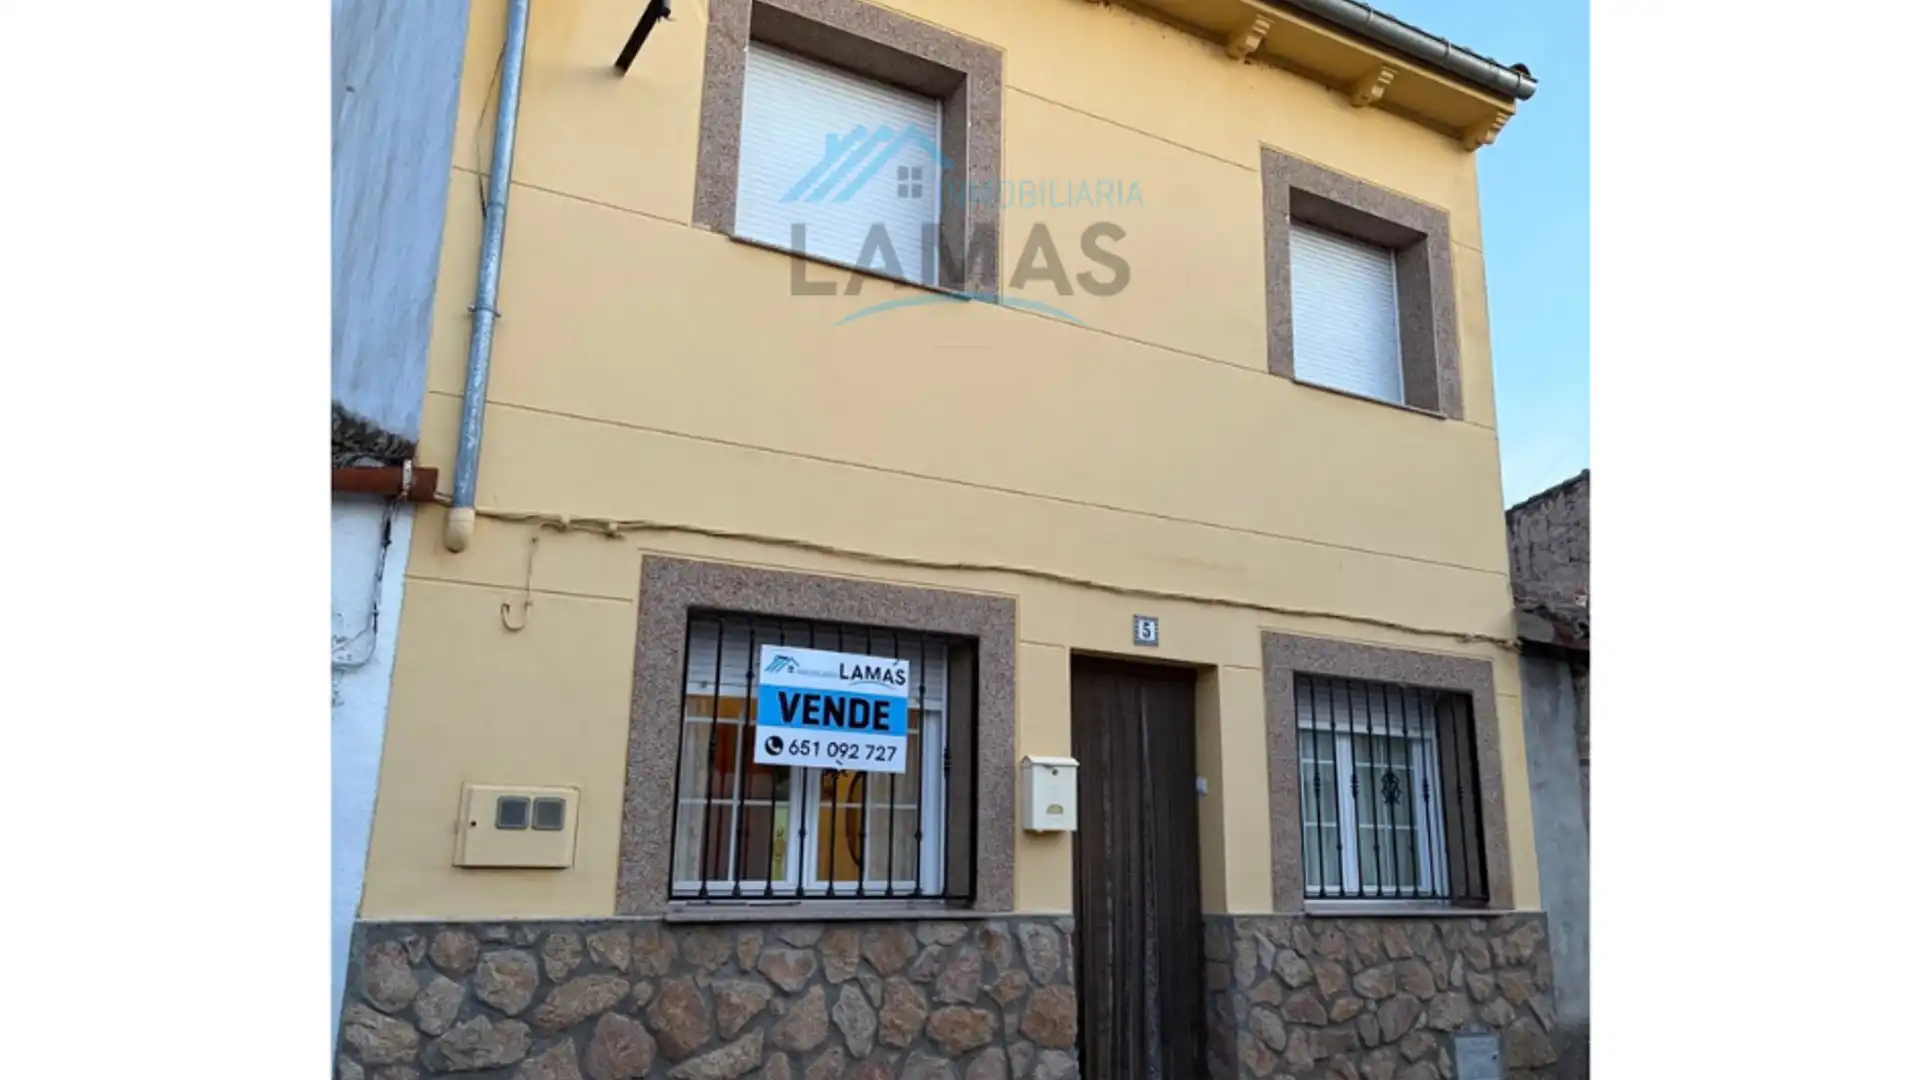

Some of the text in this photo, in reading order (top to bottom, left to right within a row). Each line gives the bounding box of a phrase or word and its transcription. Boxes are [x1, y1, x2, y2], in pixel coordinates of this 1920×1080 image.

[1142, 621, 1151, 638] 5
[839, 663, 906, 686] LAMAS
[778, 691, 890, 730] VENDE
[788, 739, 897, 762] 651 092 727
